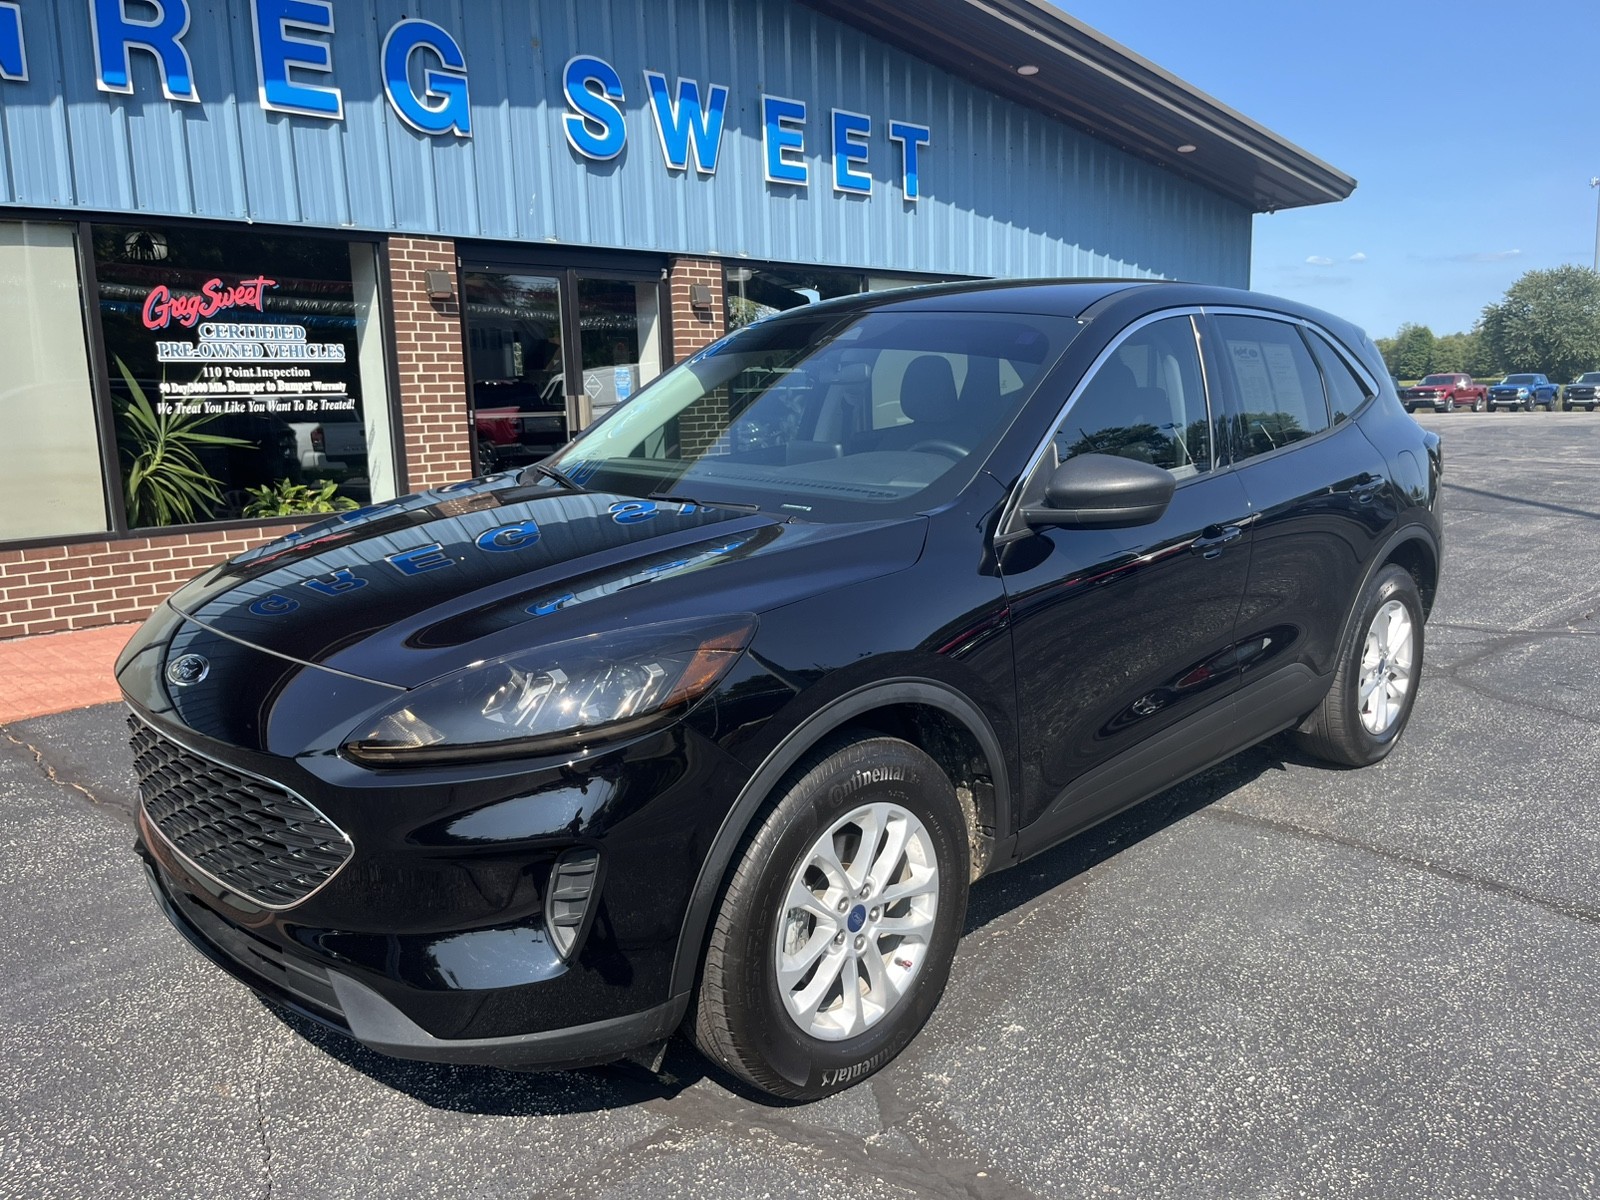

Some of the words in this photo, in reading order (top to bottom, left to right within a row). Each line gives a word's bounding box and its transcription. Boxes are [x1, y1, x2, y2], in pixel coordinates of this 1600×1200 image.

[0, 0, 472, 137] REG
[562, 54, 930, 201] SWEET
[142, 285, 201, 330] Greg
[199, 275, 279, 318] Sweet
[198, 322, 306, 340] CERTIFIED
[156, 341, 265, 358] PRE-OWNED
[265, 343, 346, 358] VEHICLES
[202, 367, 222, 378] 110
[225, 367, 254, 378] Point
[257, 366, 311, 379] Inspection
[227, 380, 265, 394] Bumper
[266, 381, 276, 392] to
[276, 380, 313, 394] Bumper
[312, 381, 346, 393] Warranty
[157, 402, 173, 415] We
[175, 402, 201, 415] Treat
[204, 402, 222, 414] You
[224, 401, 246, 413] Like
[248, 400, 265, 413] You
[267, 400, 291, 412] Want
[293, 400, 304, 411] To
[306, 399, 319, 411] Be
[320, 398, 355, 410] Treated!
